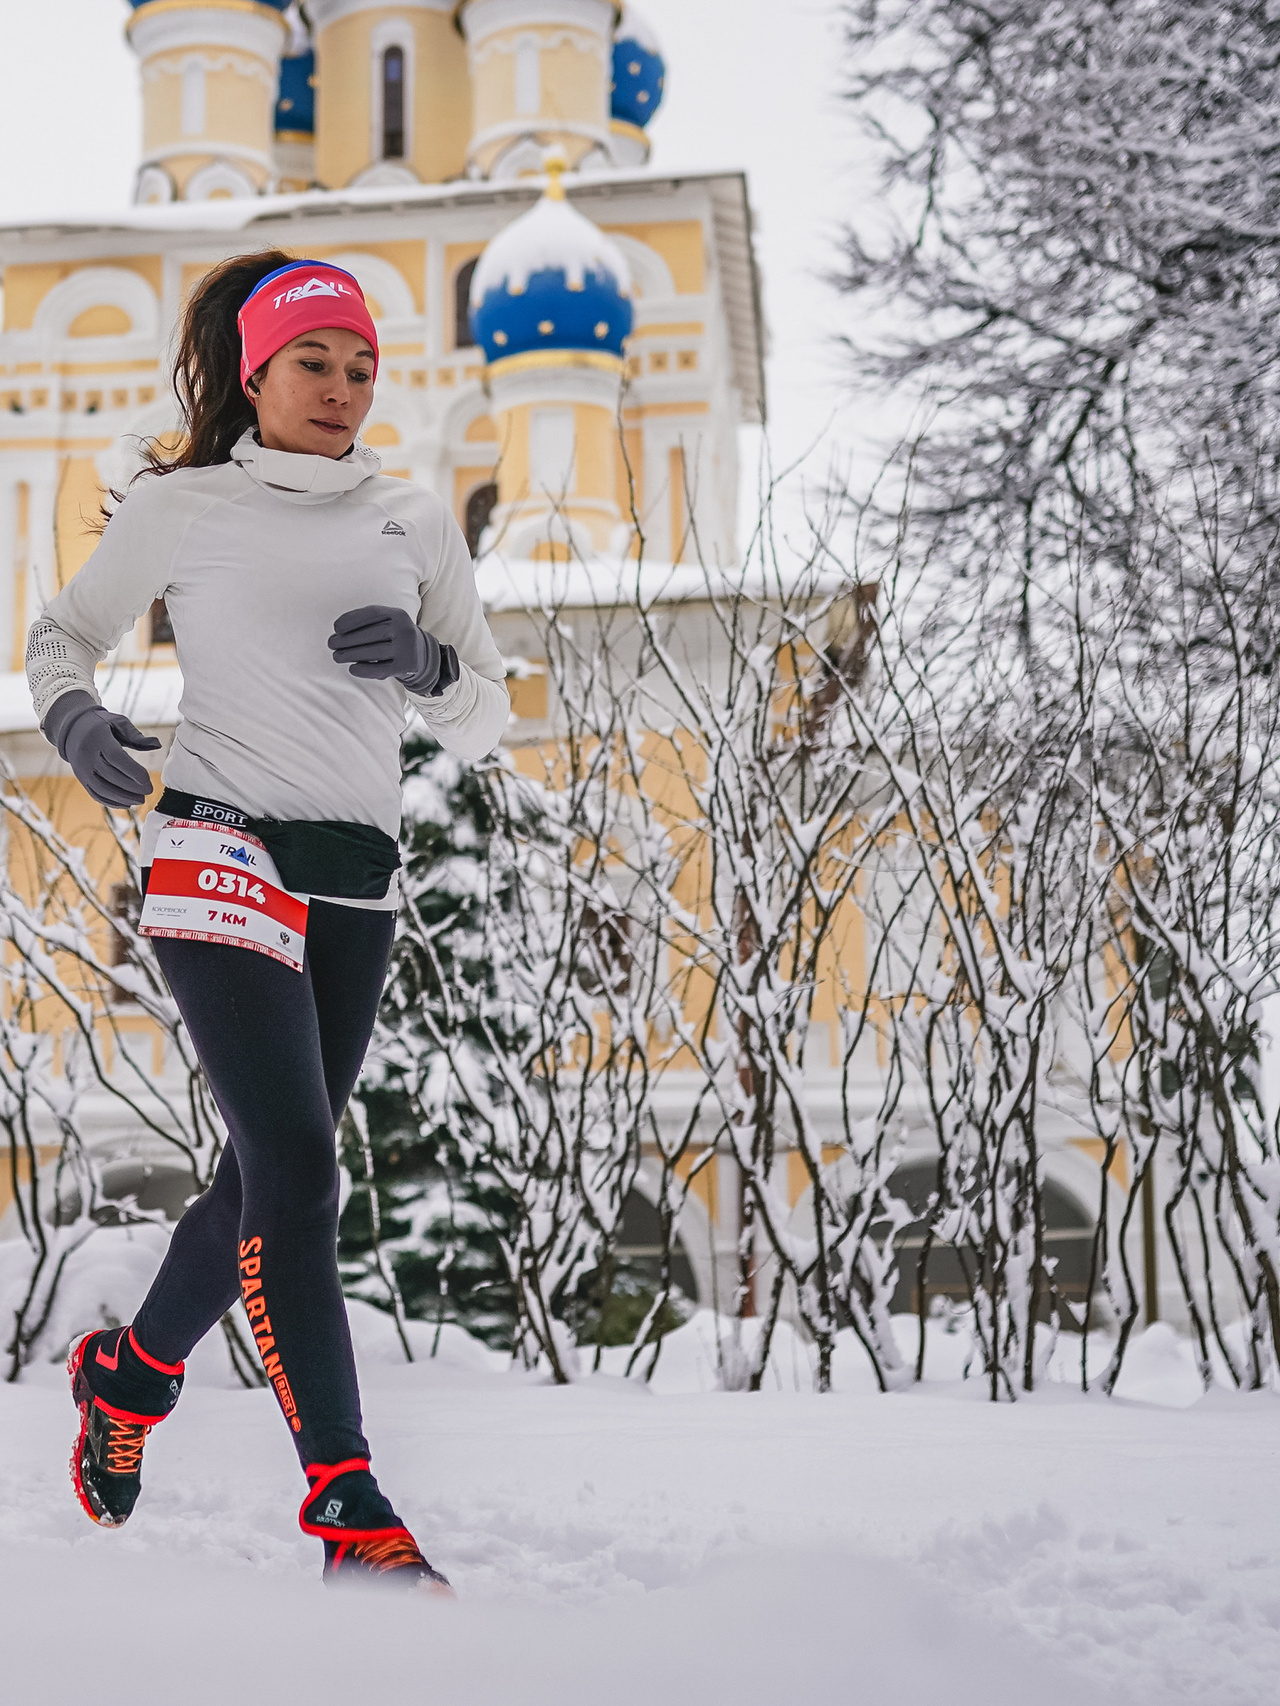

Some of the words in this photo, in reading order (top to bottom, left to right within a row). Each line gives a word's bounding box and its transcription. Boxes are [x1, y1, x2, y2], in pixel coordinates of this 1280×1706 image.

[273, 278, 351, 309] TRAIL
[192, 804, 248, 824] SPORT
[219, 844, 256, 866] TRAIL
[197, 868, 266, 905] 0314
[207, 910, 218, 921] 7
[222, 913, 247, 927] KM
[239, 1236, 283, 1378] SPARTAN
[277, 1379, 294, 1414] RACE
